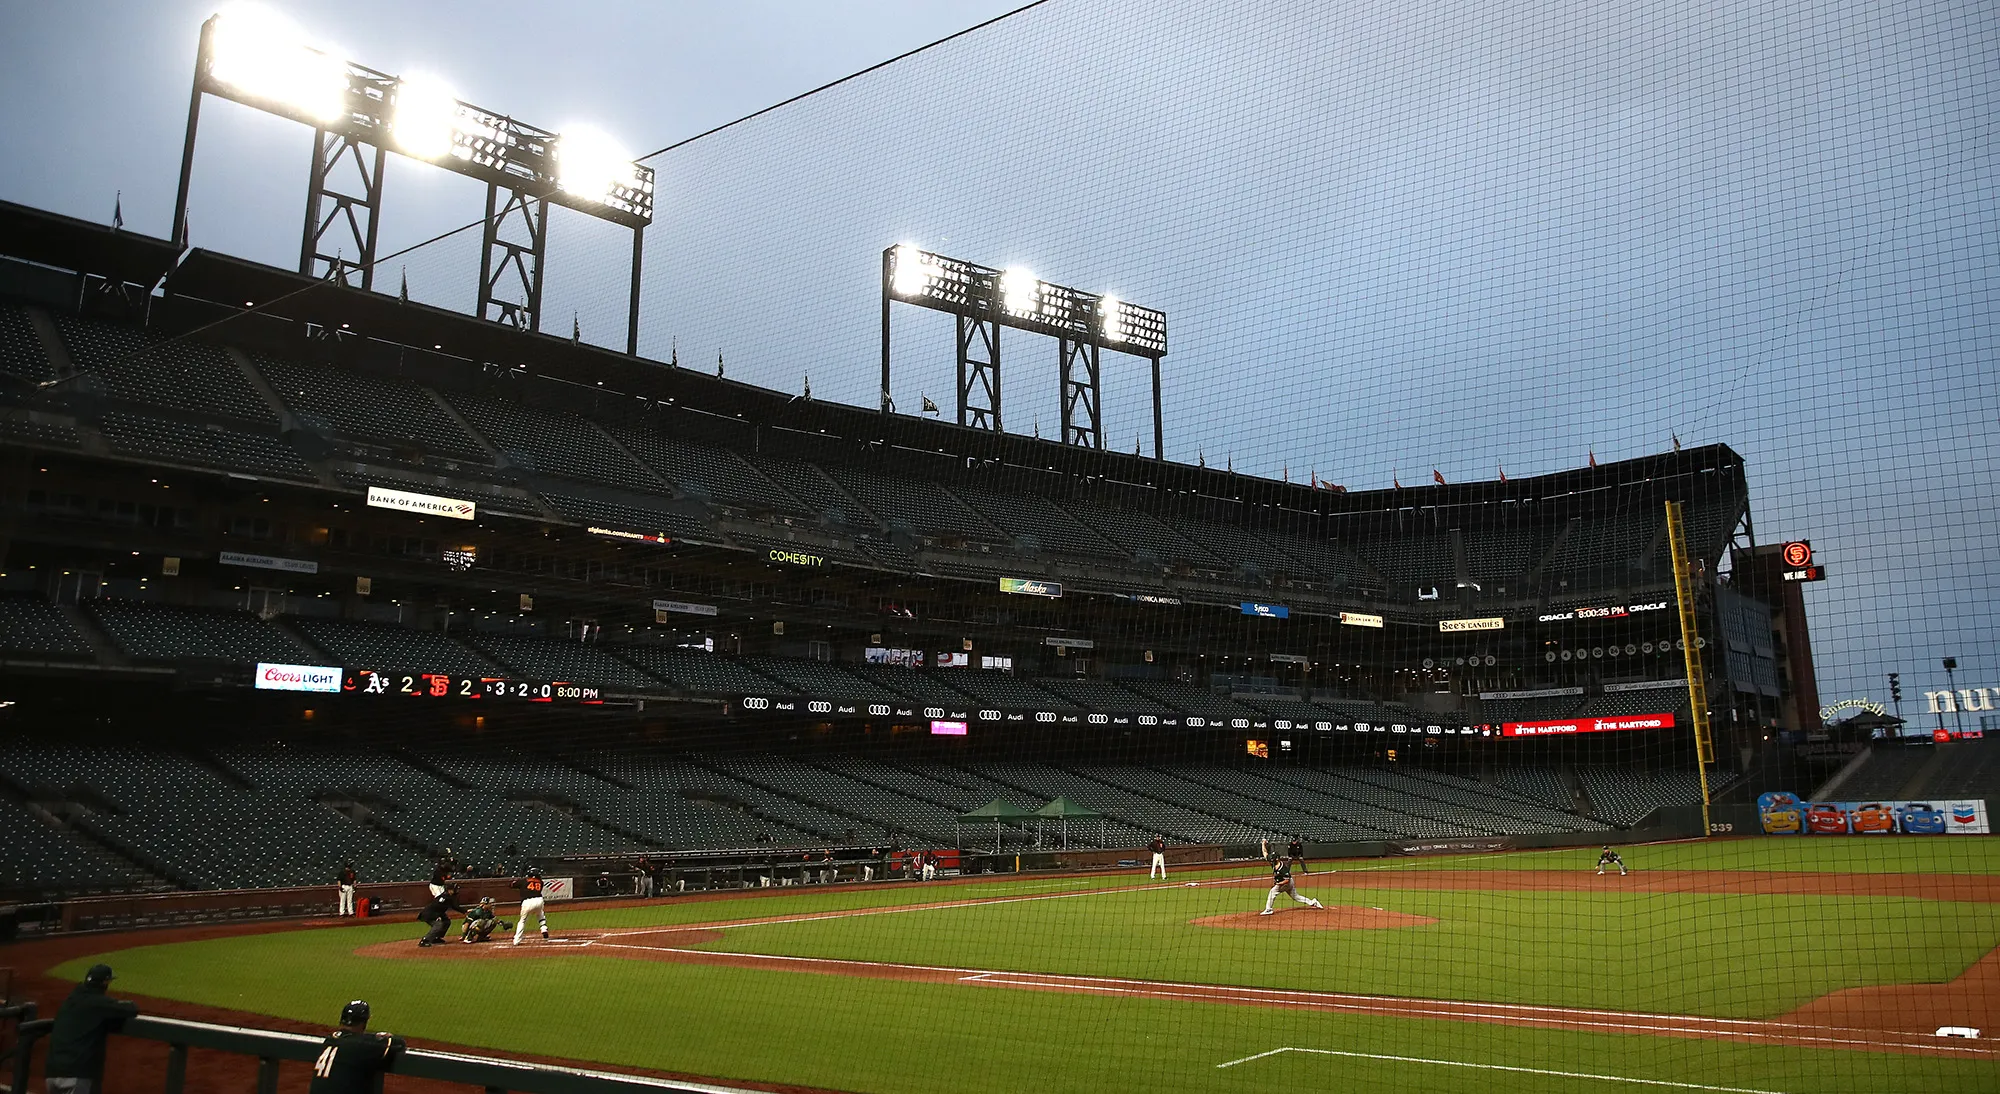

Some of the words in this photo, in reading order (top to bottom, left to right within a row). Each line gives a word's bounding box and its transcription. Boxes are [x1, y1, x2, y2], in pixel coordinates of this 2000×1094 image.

[370, 494, 396, 504] BANK
[412, 501, 454, 513] AMERICA
[769, 550, 824, 567] COHESITY
[1783, 572, 1794, 580] WE
[1795, 570, 1807, 579] ARE
[1017, 580, 1047, 594] Alaska
[1137, 594, 1158, 603] KONICA
[1158, 597, 1181, 606] MINOLTA
[1254, 603, 1270, 613] Sysco
[1539, 612, 1574, 622] ORACLE
[1578, 608, 1609, 619] 8:00:35
[1611, 606, 1625, 615] PM
[1629, 602, 1667, 612] ORACLE
[1442, 621, 1466, 630] See's
[1468, 621, 1500, 629] CANDIES
[265, 668, 301, 682] Coors
[303, 674, 334, 684] LIGHT
[363, 672, 390, 694] A's
[400, 676, 414, 693] 2
[460, 679, 472, 696] 2
[486, 684, 492, 692] b
[495, 682, 505, 696] 3
[518, 683, 528, 697] 2
[541, 684, 551, 698] 0
[557, 687, 580, 698] 8:00
[582, 688, 599, 699] PM
[776, 702, 794, 710] Audi
[838, 705, 855, 713] Audi
[896, 708, 912, 716] Audi
[950, 711, 967, 719] Audi
[1007, 713, 1024, 721] Audi
[1819, 697, 1886, 720] Ghirardelli
[1537, 725, 1577, 734] HARTFORD
[1618, 720, 1661, 729] HARTFORD
[1710, 823, 1733, 832] 339
[526, 882, 541, 891] 48
[313, 1045, 339, 1078] 41
